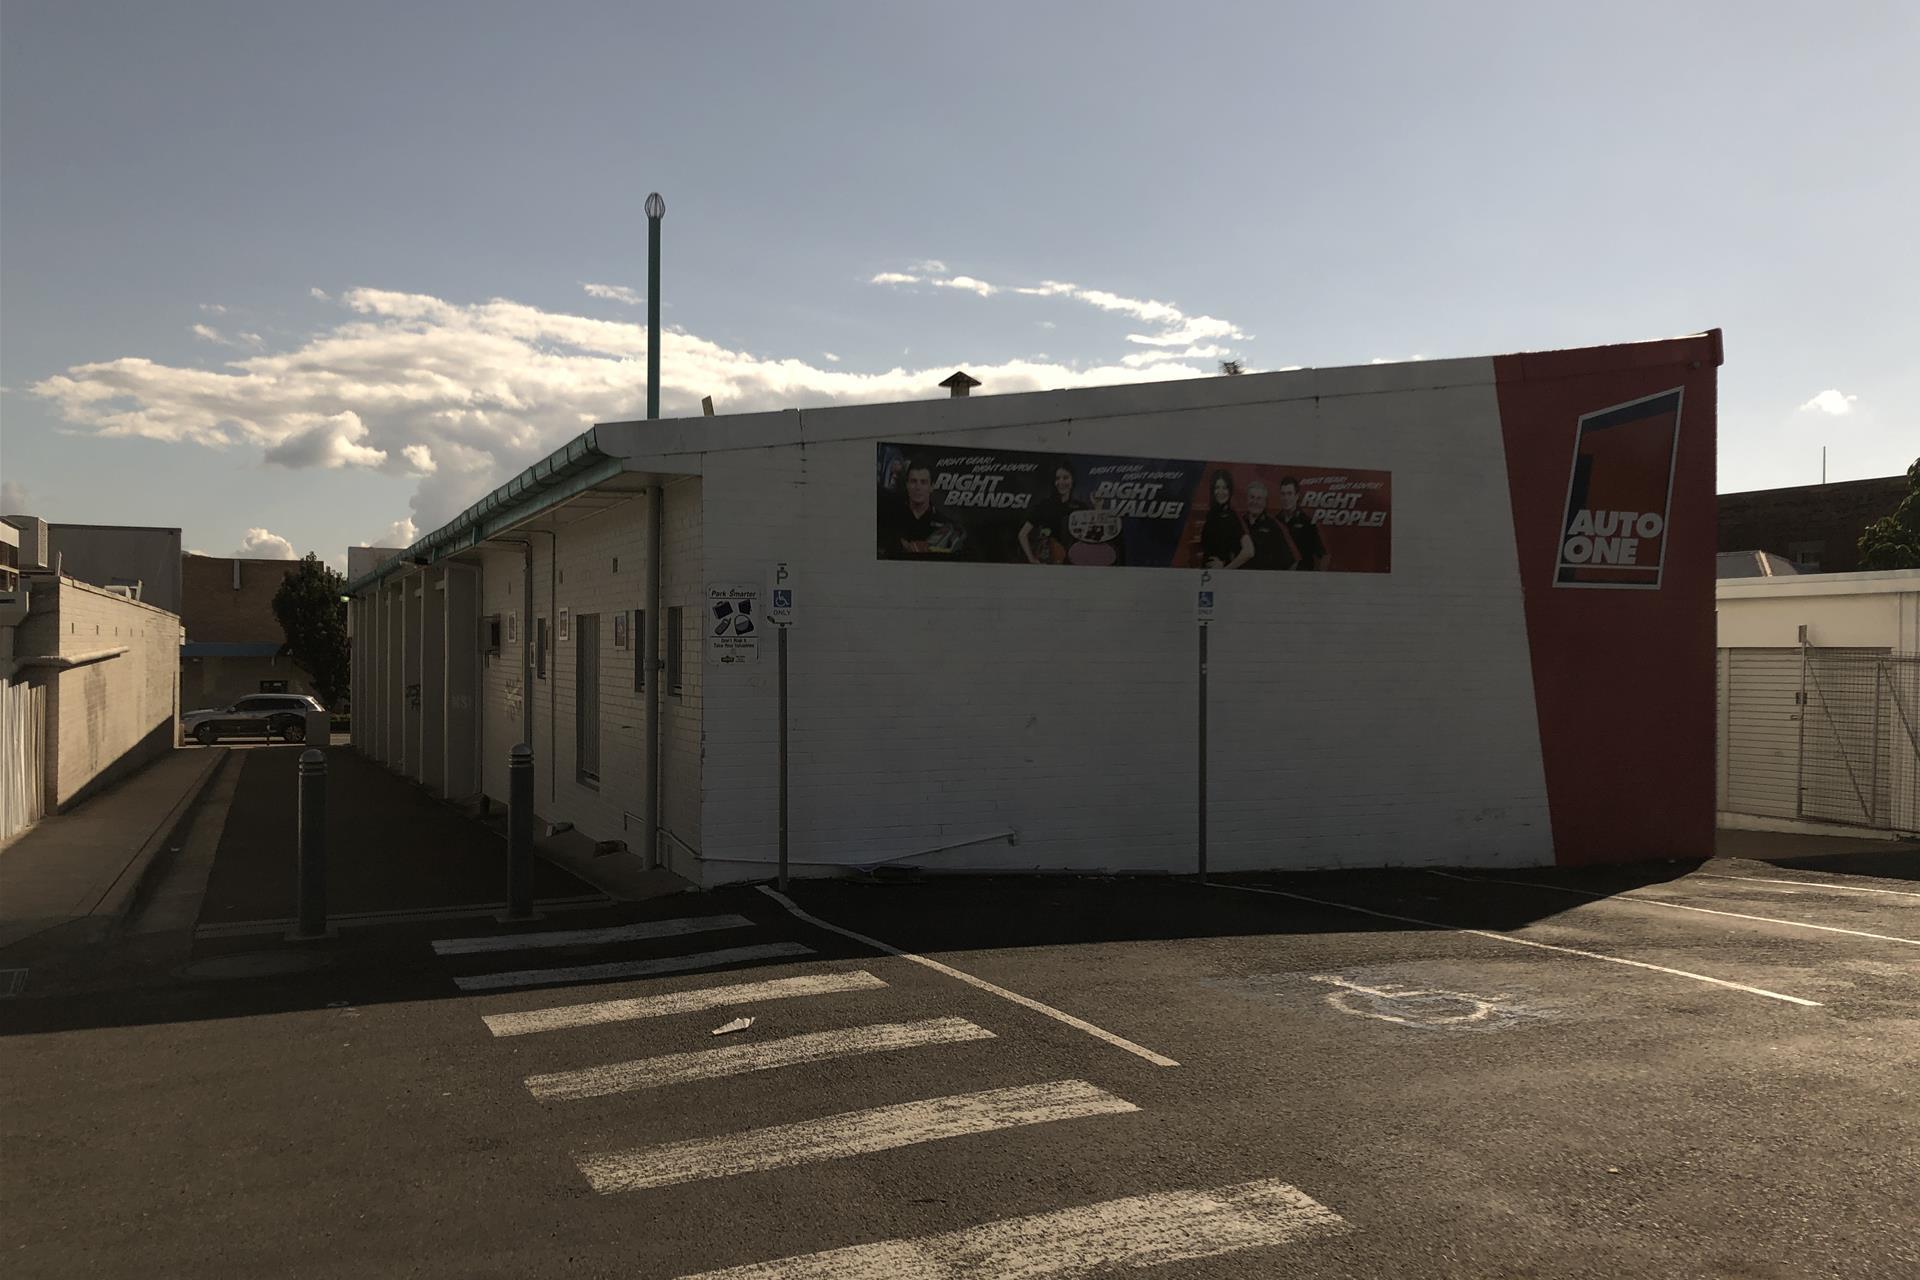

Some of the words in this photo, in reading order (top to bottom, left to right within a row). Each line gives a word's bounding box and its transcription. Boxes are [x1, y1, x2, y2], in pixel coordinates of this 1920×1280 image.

[934, 473, 1004, 492] RIGHT
[1095, 481, 1163, 500] RIGHT
[944, 491, 1032, 509] BRANDS!
[1108, 499, 1185, 519] VALUE!
[1300, 491, 1362, 509] RIGHT
[1311, 509, 1387, 527] PEOPLE!
[1567, 509, 1663, 538] AUTO
[1563, 535, 1638, 565] ONE
[777, 569, 789, 585] P
